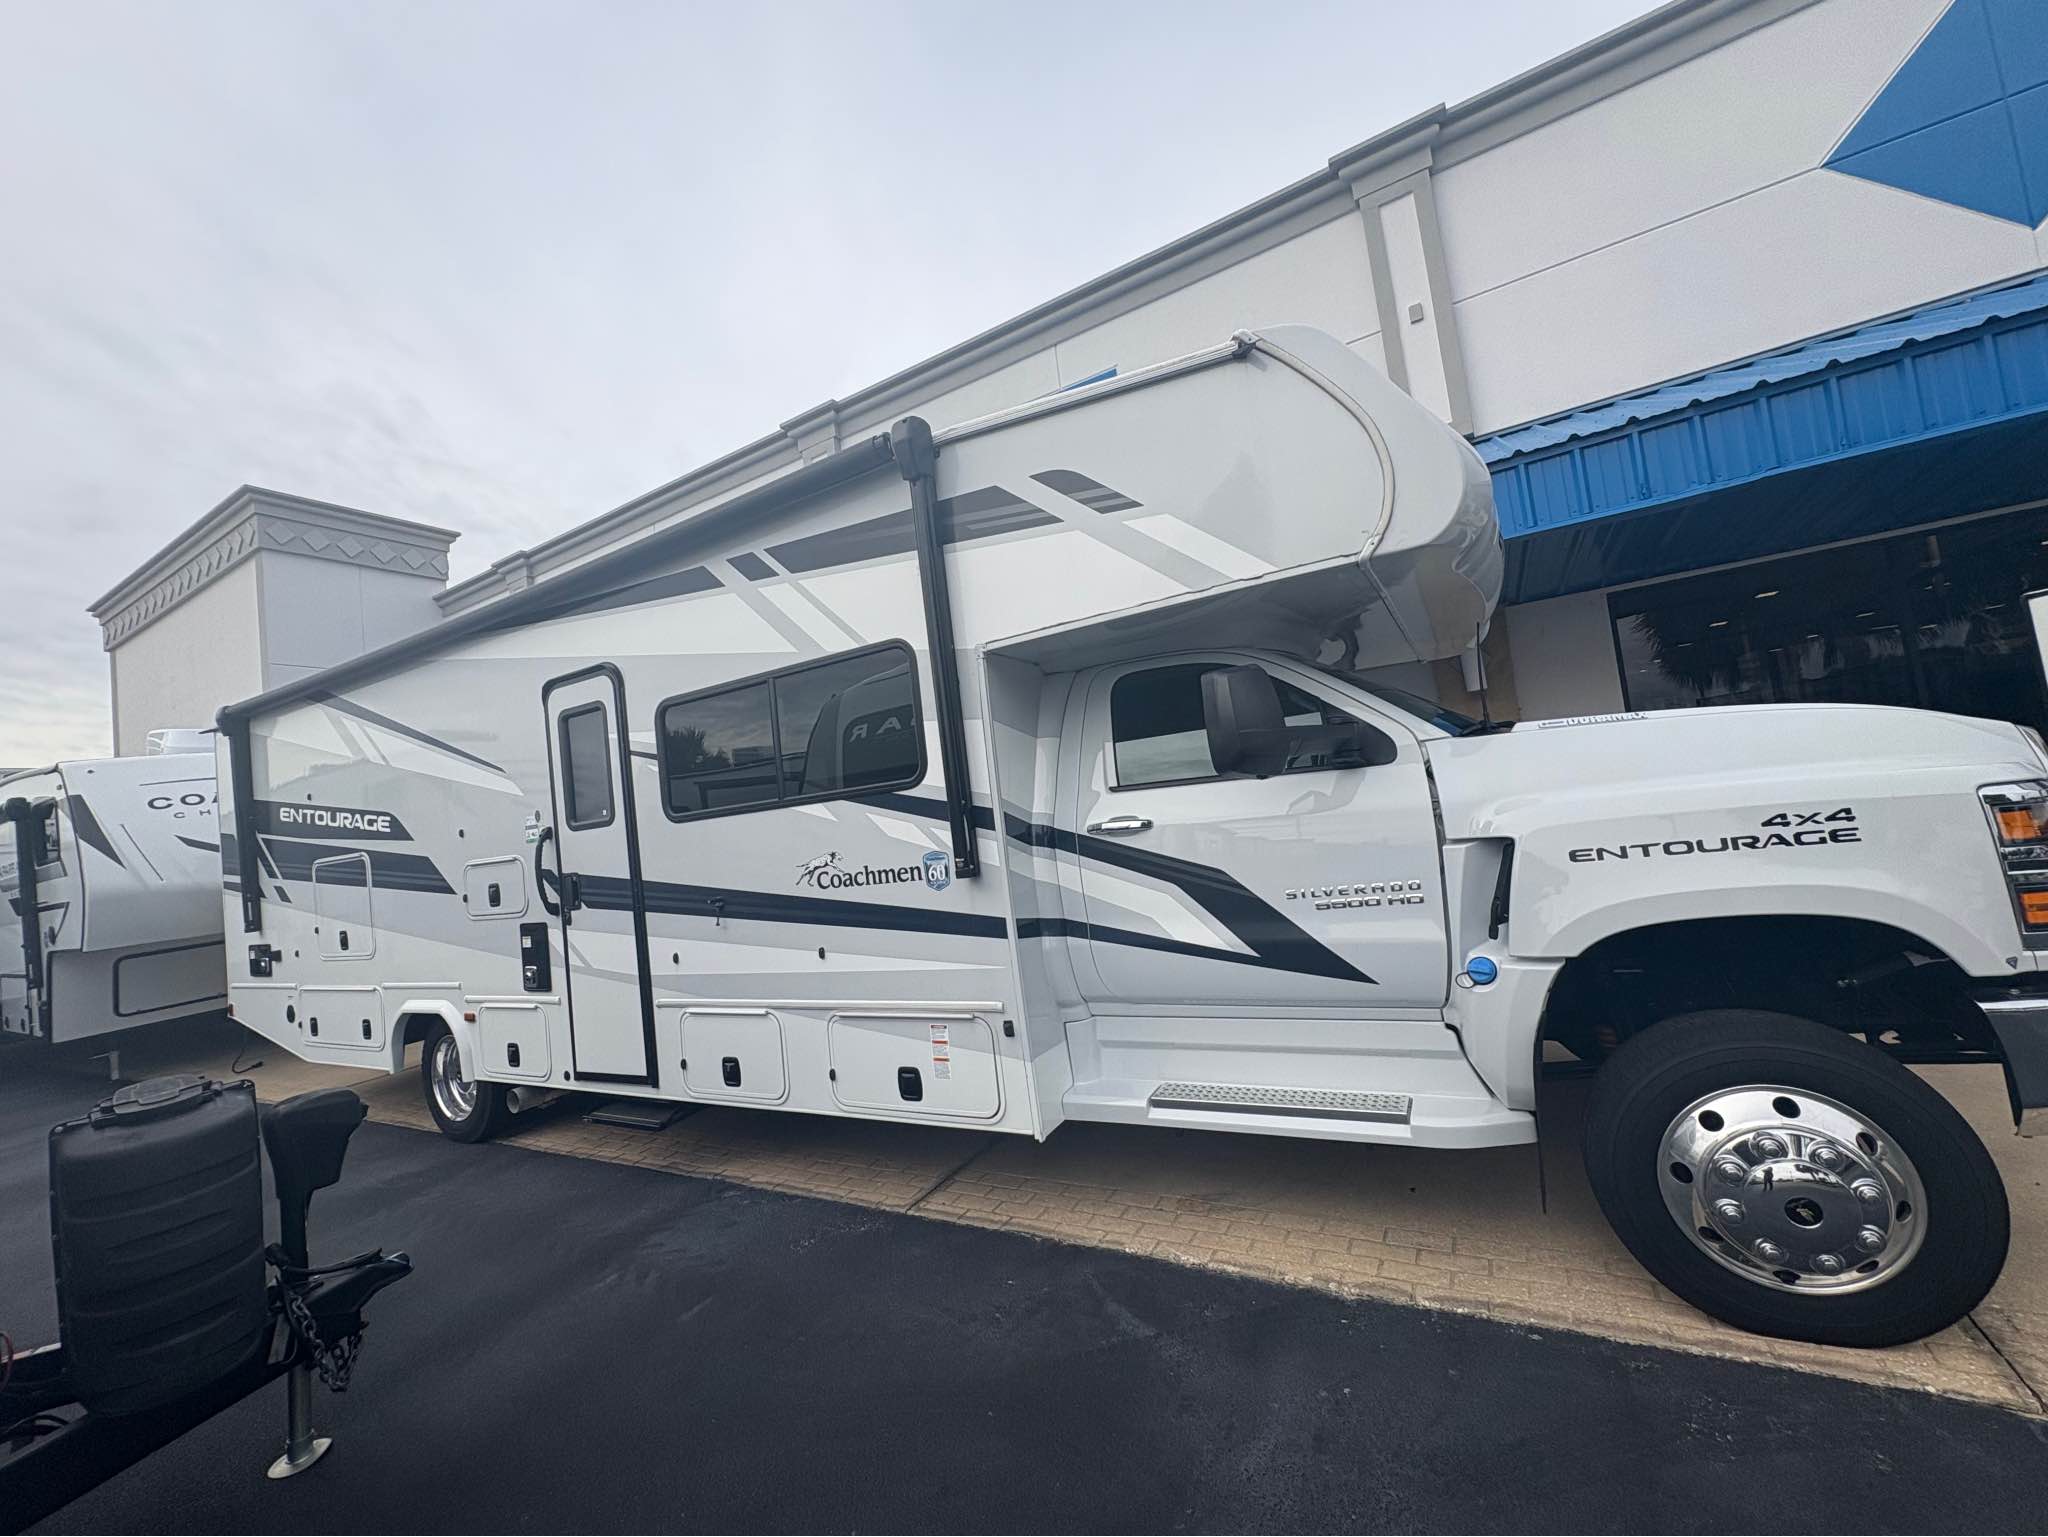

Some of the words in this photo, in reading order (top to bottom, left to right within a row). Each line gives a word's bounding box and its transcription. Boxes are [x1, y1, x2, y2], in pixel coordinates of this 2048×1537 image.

[280, 807, 391, 832] ENTOURAGE
[1568, 827, 1862, 862] ENTOURAGE
[817, 865, 923, 889] Coachmen
[928, 864, 946, 881] 60
[1285, 880, 1422, 900] SILVERADO
[1315, 896, 1381, 910] 5500
[1387, 893, 1424, 905] HD
